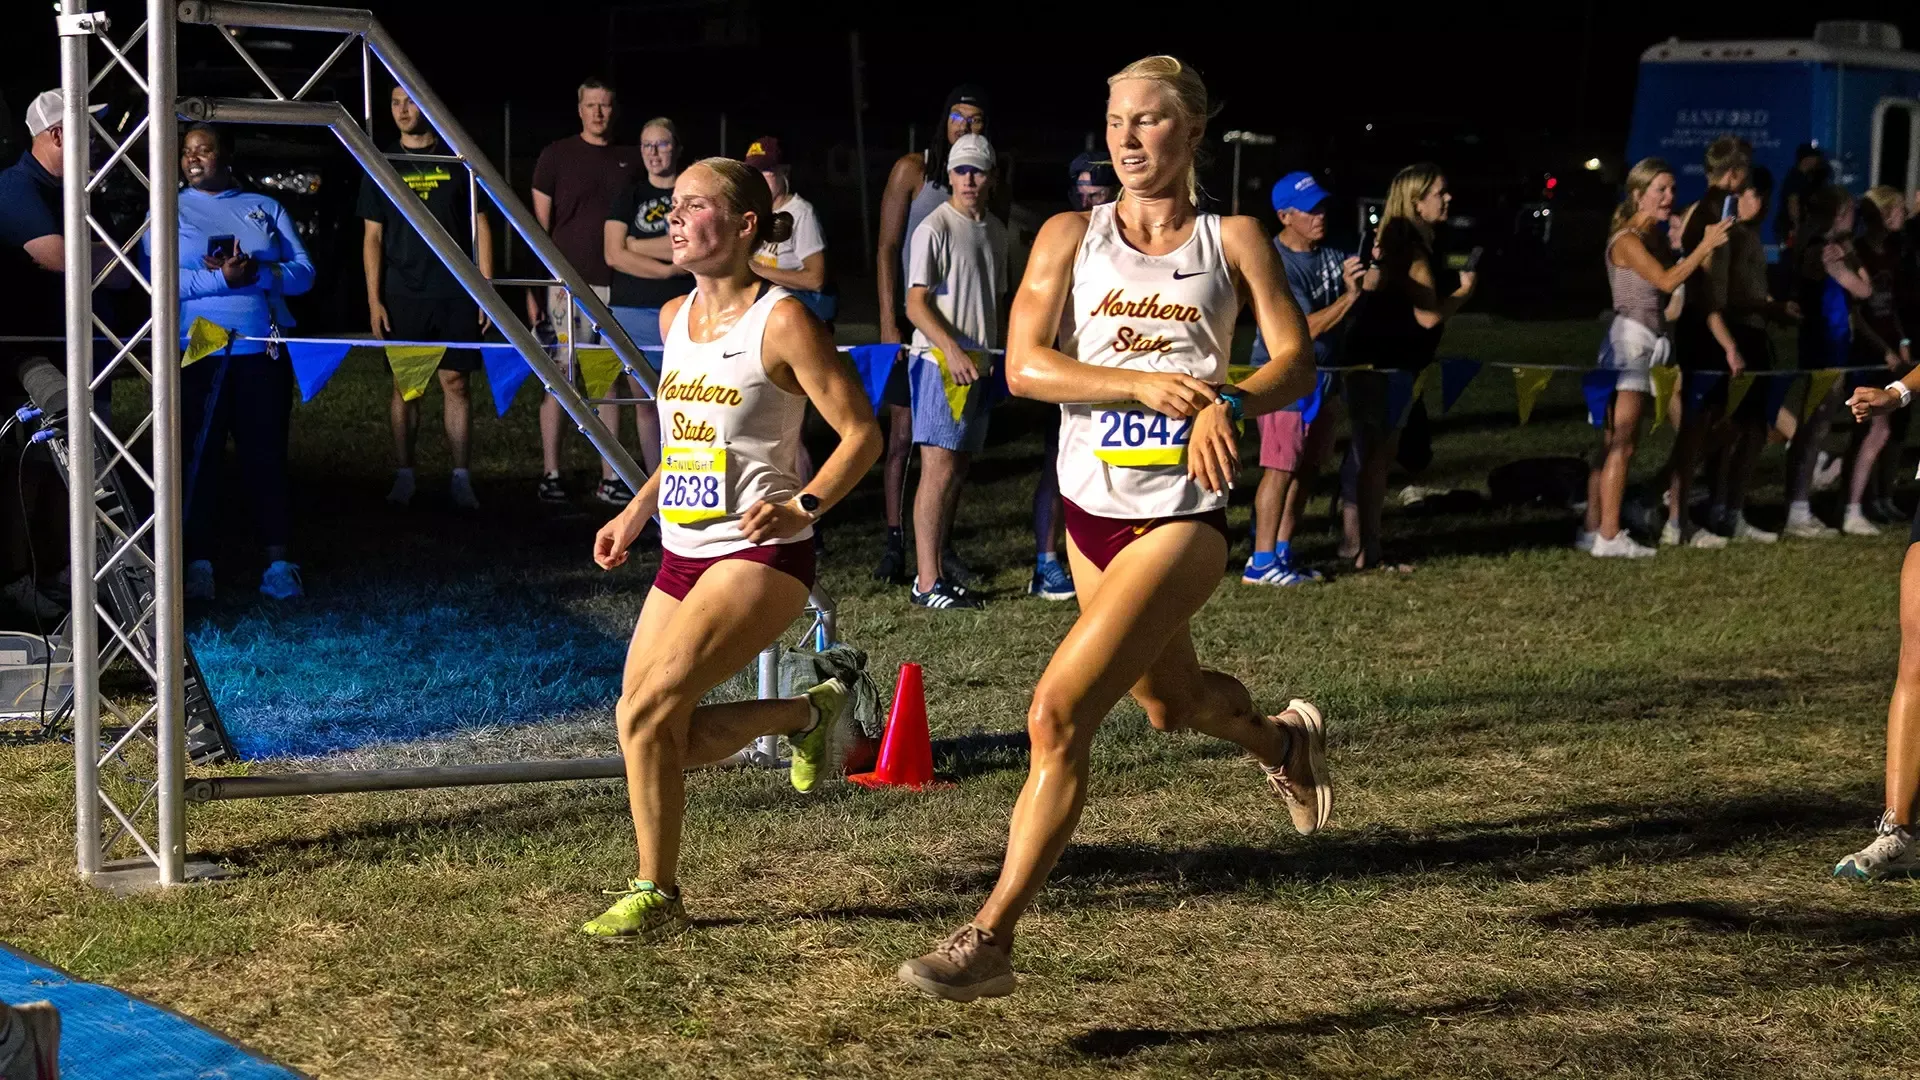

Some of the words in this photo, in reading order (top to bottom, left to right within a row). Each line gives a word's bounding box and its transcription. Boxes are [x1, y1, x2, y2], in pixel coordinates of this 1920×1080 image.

[1090, 288, 1202, 323] Northern
[1113, 326, 1173, 353] State
[672, 411, 717, 442] State
[1100, 409, 1193, 447] 2642
[673, 459, 715, 471] TWILIGHT
[662, 474, 720, 509] 2638
